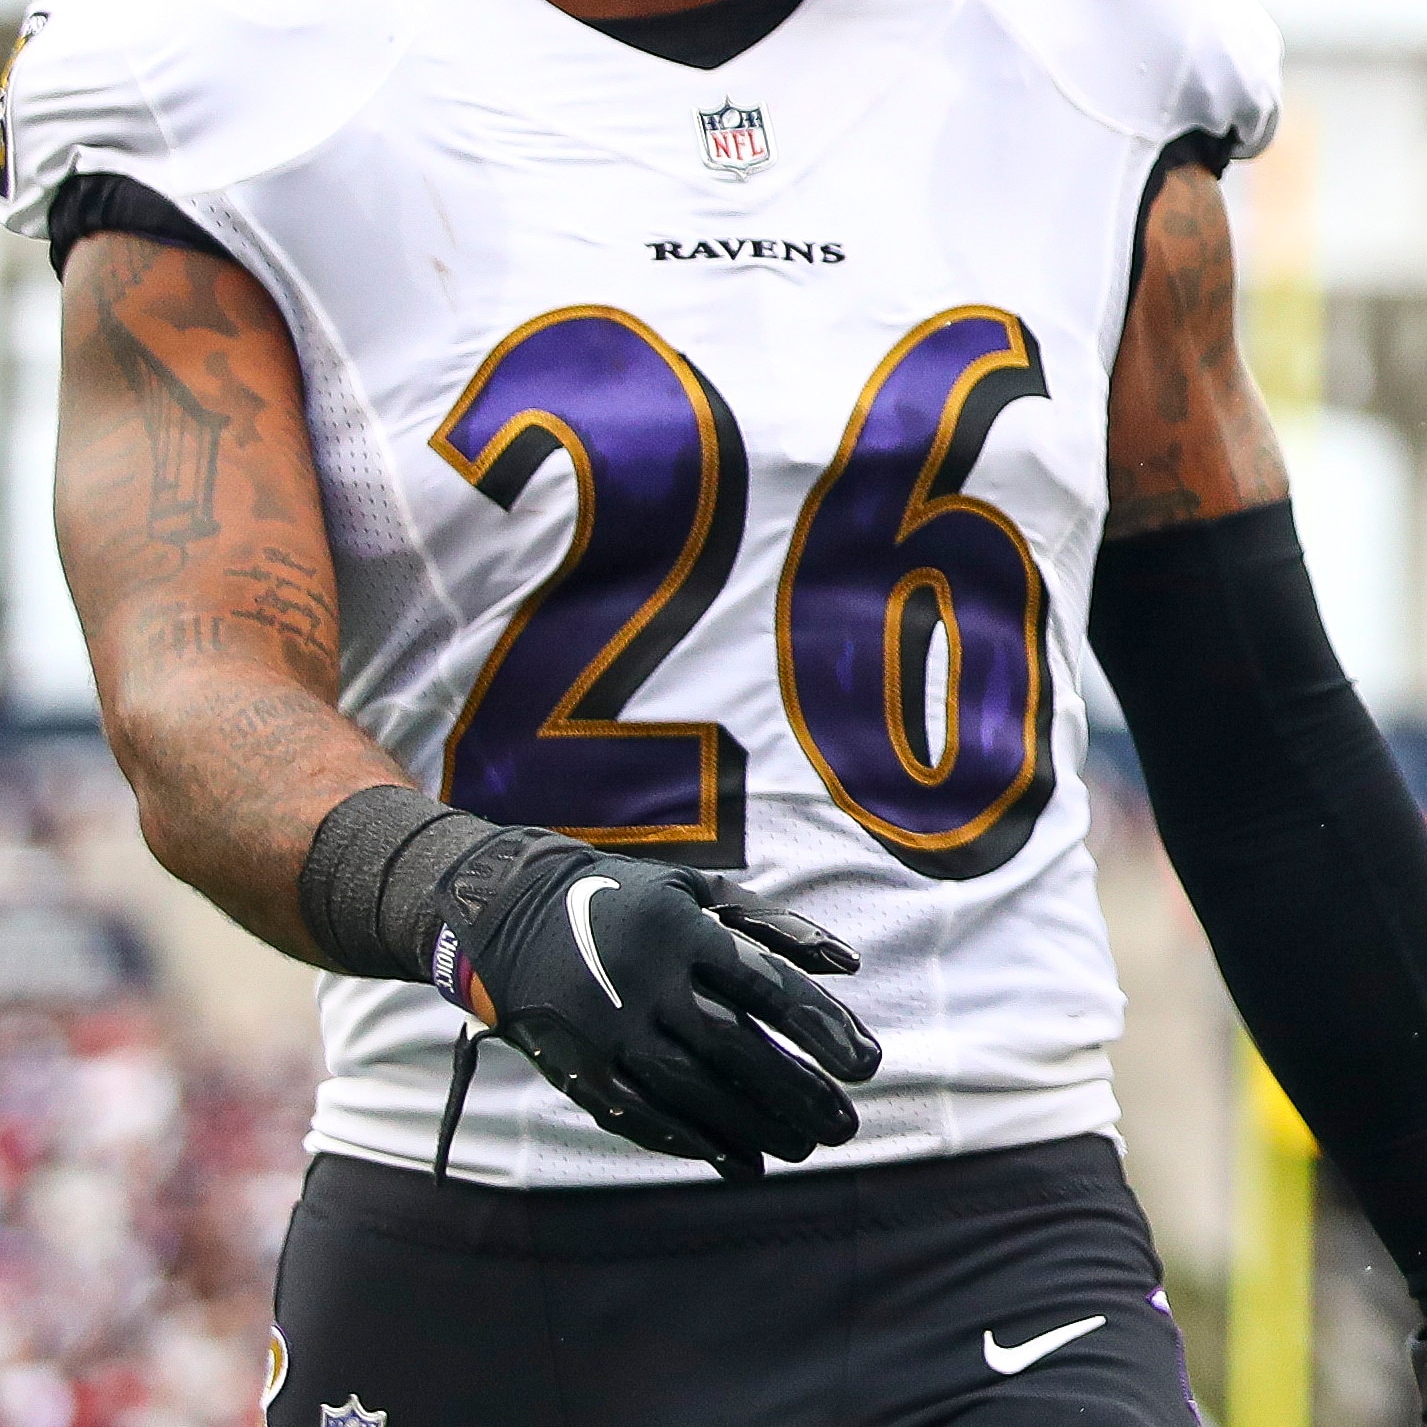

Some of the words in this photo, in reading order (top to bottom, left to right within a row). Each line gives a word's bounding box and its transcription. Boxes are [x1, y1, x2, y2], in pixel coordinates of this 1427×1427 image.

[710, 128, 766, 161] NFL
[644, 237, 846, 264] RAVENS
[428, 304, 1056, 881] 26
